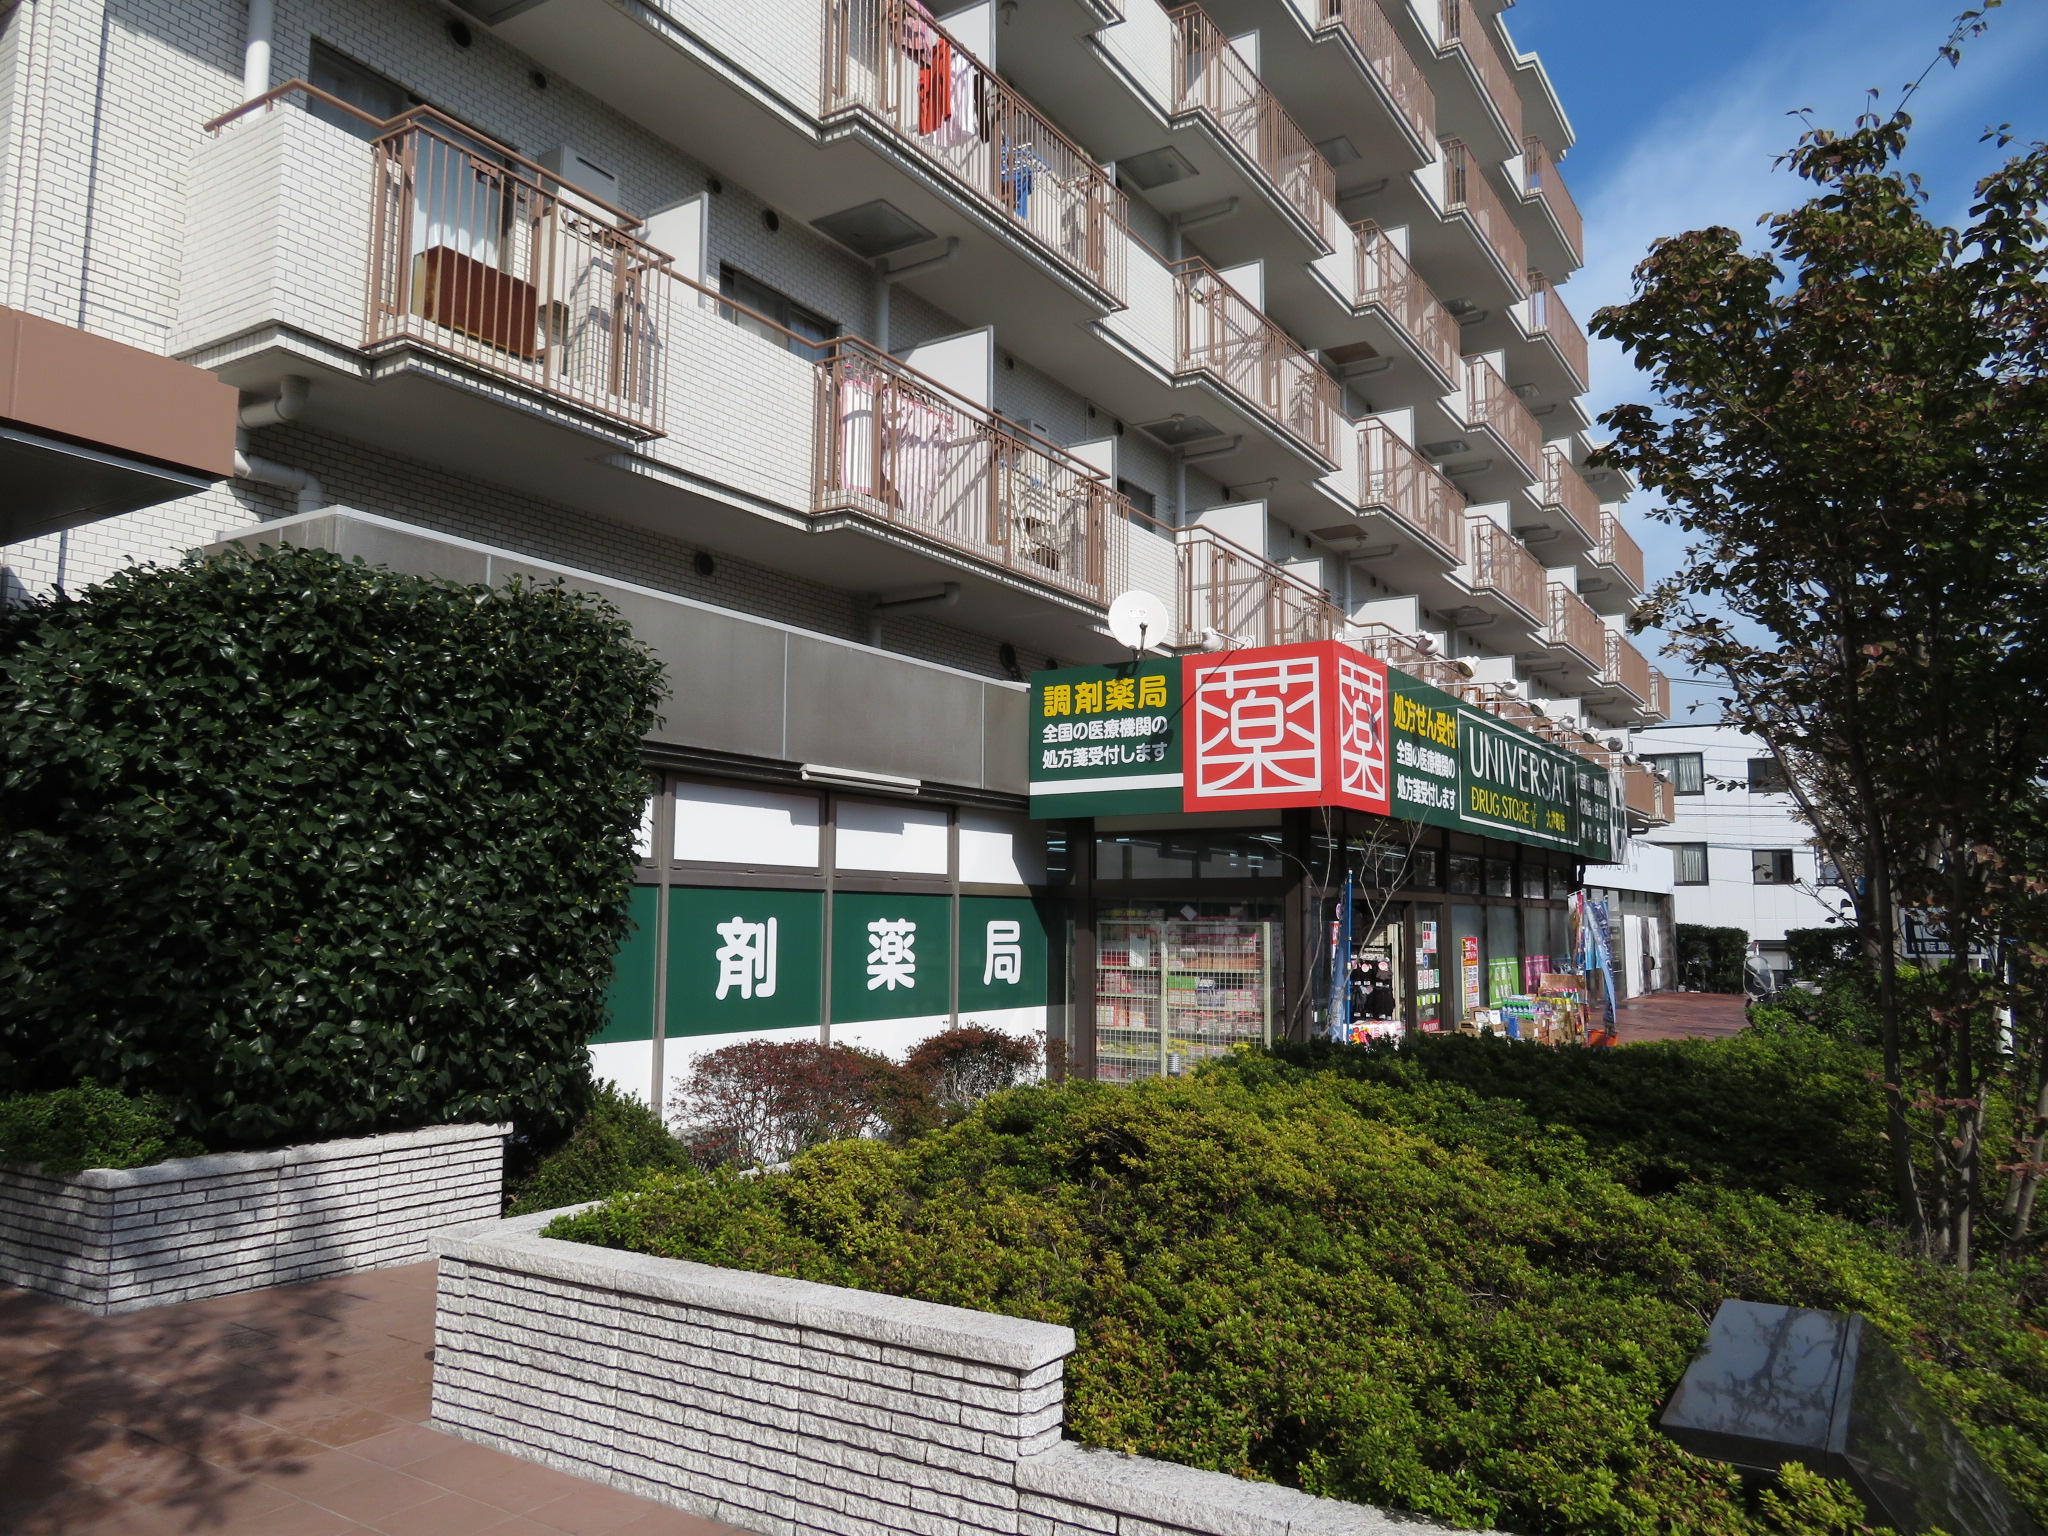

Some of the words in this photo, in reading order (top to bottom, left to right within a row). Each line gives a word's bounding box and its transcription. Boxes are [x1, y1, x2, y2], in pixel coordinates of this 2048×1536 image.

[1043, 675, 1168, 717] 調剤薬局
[1042, 715, 1168, 744] 全国の医療機関の
[1196, 656, 1322, 798] 薬
[1338, 656, 1386, 802] 薬
[1393, 692, 1457, 749] 処方せん受付
[1042, 742, 1168, 770] 処方箋受付します
[1396, 738, 1456, 779] 全国の医療機関の
[1469, 726, 1571, 807] UNIVERSAL
[1397, 773, 1456, 811] 処方箋受付します
[1471, 786, 1500, 817] DRUG
[1501, 795, 1530, 825] STORE
